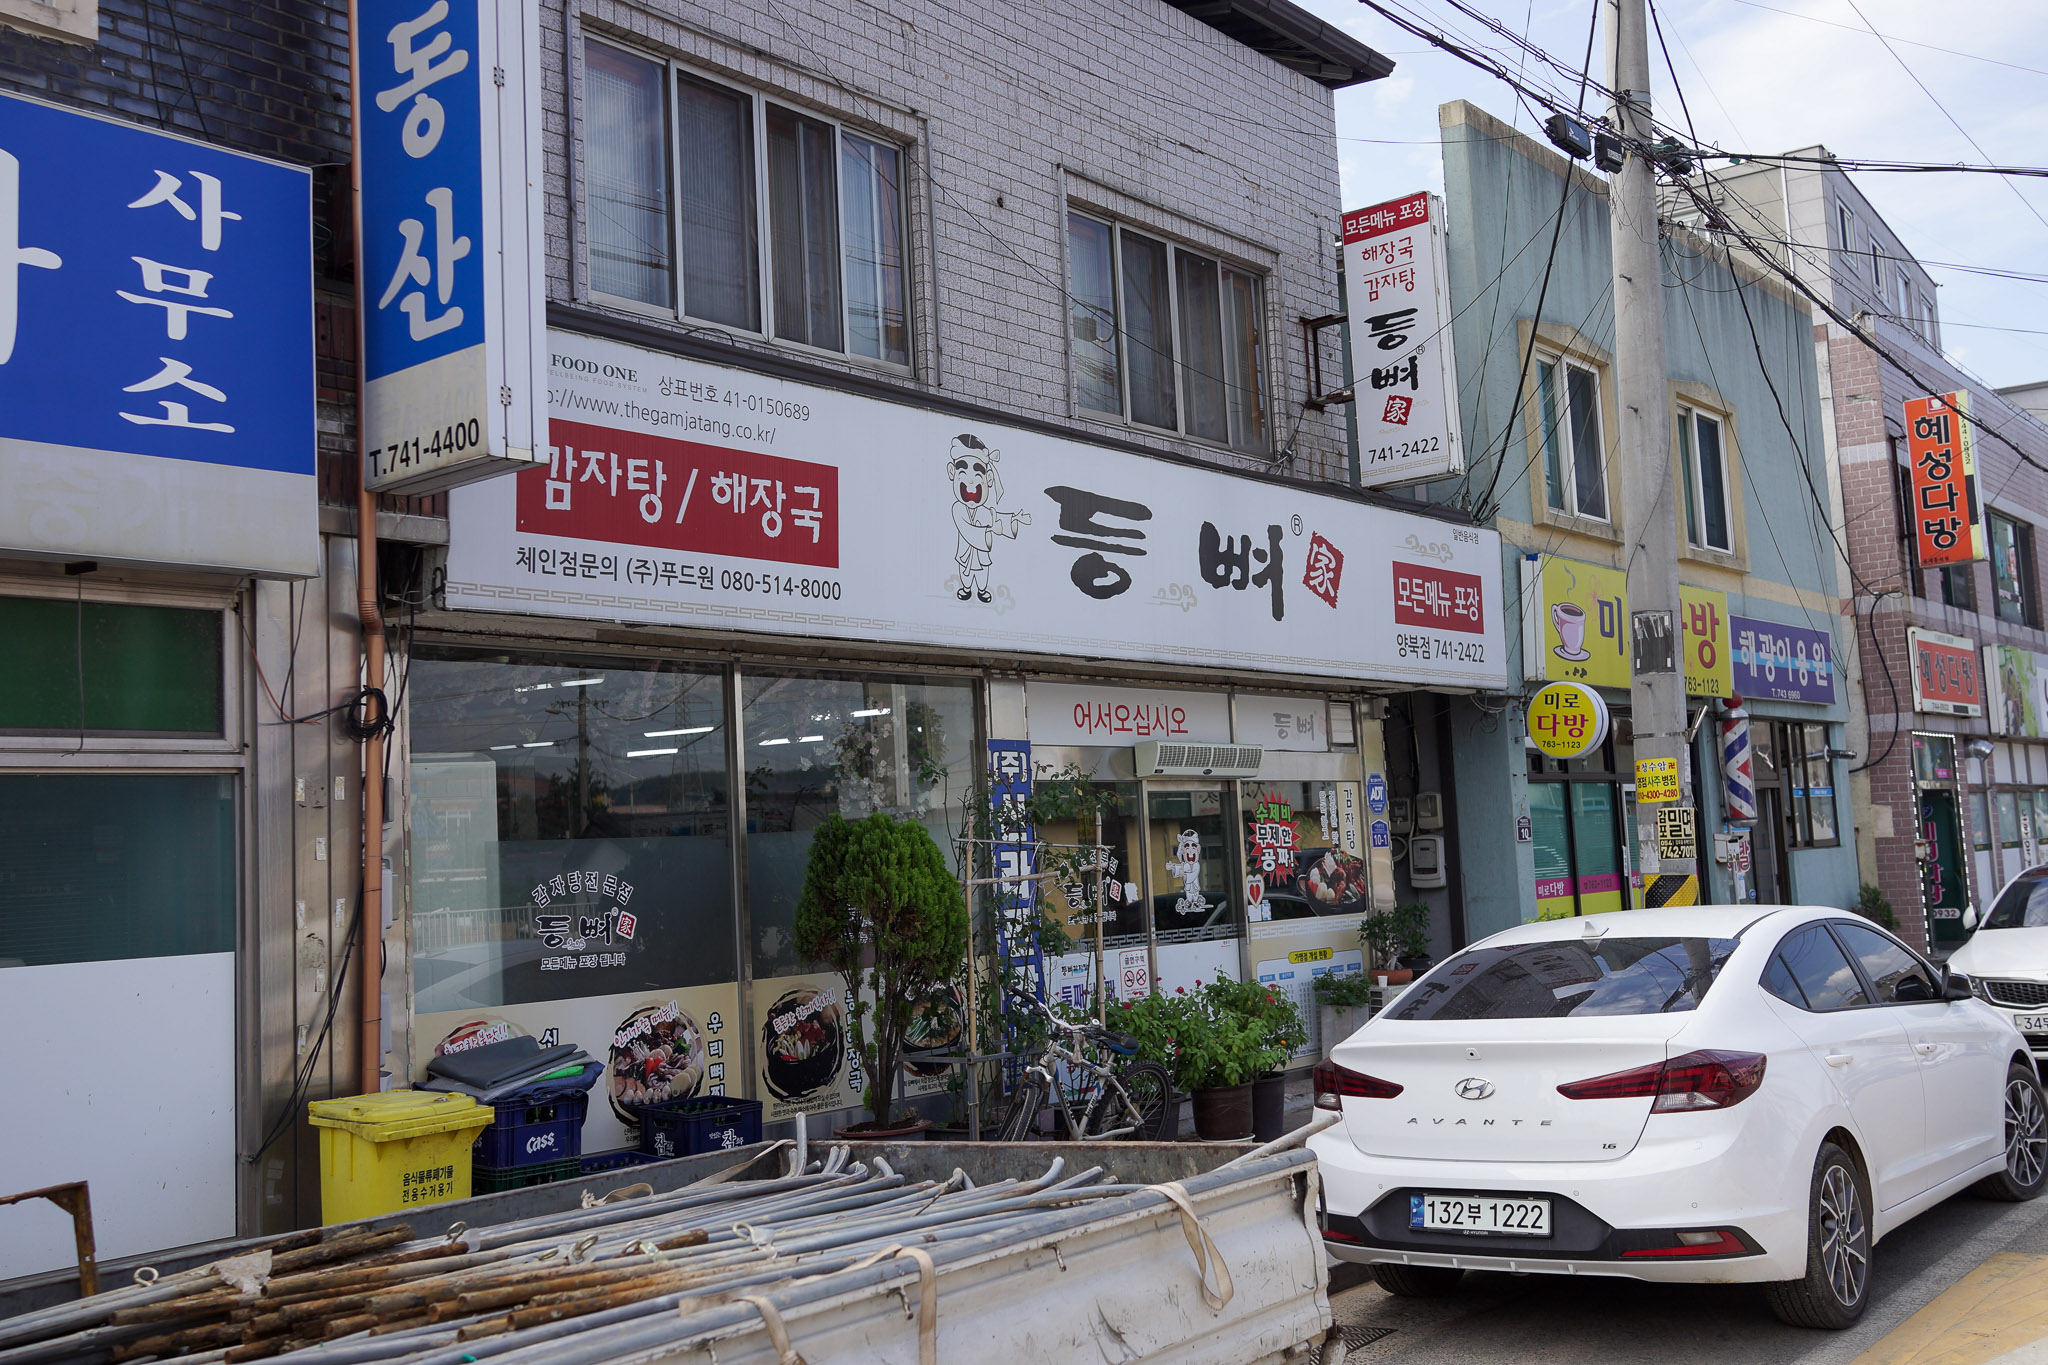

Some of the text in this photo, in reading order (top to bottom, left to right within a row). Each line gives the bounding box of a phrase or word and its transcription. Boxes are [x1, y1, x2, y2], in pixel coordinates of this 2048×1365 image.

[376, 0, 470, 341] 동산
[1344, 198, 1426, 237] 모든메뉴 포장
[1361, 236, 1414, 265] 해장국
[1364, 268, 1416, 302] 감자탕
[116, 170, 242, 433] 사무소
[551, 353, 638, 383] FOOD ONE
[592, 378, 614, 387] FOOD
[617, 382, 647, 393] SYSTEM
[658, 375, 811, 421] 상표번호 41-0150689
[368, 418, 480, 479] T.741-4400
[1368, 436, 1440, 465] 741-2422
[545, 445, 667, 524] 감자탕
[710, 471, 824, 544] 해장국
[1914, 413, 1963, 550] 혜성다방
[1452, 528, 1479, 545] 일반음식점
[515, 545, 842, 601] 체인점문의 (주)푸드원 080-514-8000
[1397, 577, 1480, 622] 모든메뉴 포장
[1396, 633, 1485, 663] 양북점 741-2422
[1738, 630, 1828, 687] 해광이용원
[1543, 692, 1580, 710] 미로
[1073, 700, 1189, 737] 어서오십시오
[1536, 713, 1589, 738] 다방
[1541, 740, 1581, 749] 763-1123
[1370, 786, 1384, 801] ADT
[1661, 774, 1677, 787] 병점
[1255, 801, 1291, 824] 수제비
[1343, 788, 1356, 850] 감자탕
[1668, 808, 1693, 838] 밀면
[1256, 823, 1293, 847] 무제한
[1374, 834, 1388, 846] 10-1
[1520, 828, 1529, 839] 10
[1261, 847, 1295, 872] 공짜!
[531, 870, 634, 909] 감자탕전문점
[1537, 881, 1565, 897] 미로다방
[541, 952, 627, 971] 모든메뉴 포장 됩니다
[613, 1000, 680, 1048] 인기가족 메뉴!!
[772, 1011, 796, 1035] 든든한
[1406, 1117, 1553, 1127] AVANTE
[402, 1165, 454, 1188] 음식물류폐기물
[402, 1180, 454, 1204] 전용수거용기
[1427, 1200, 1543, 1230] 132부 1222
